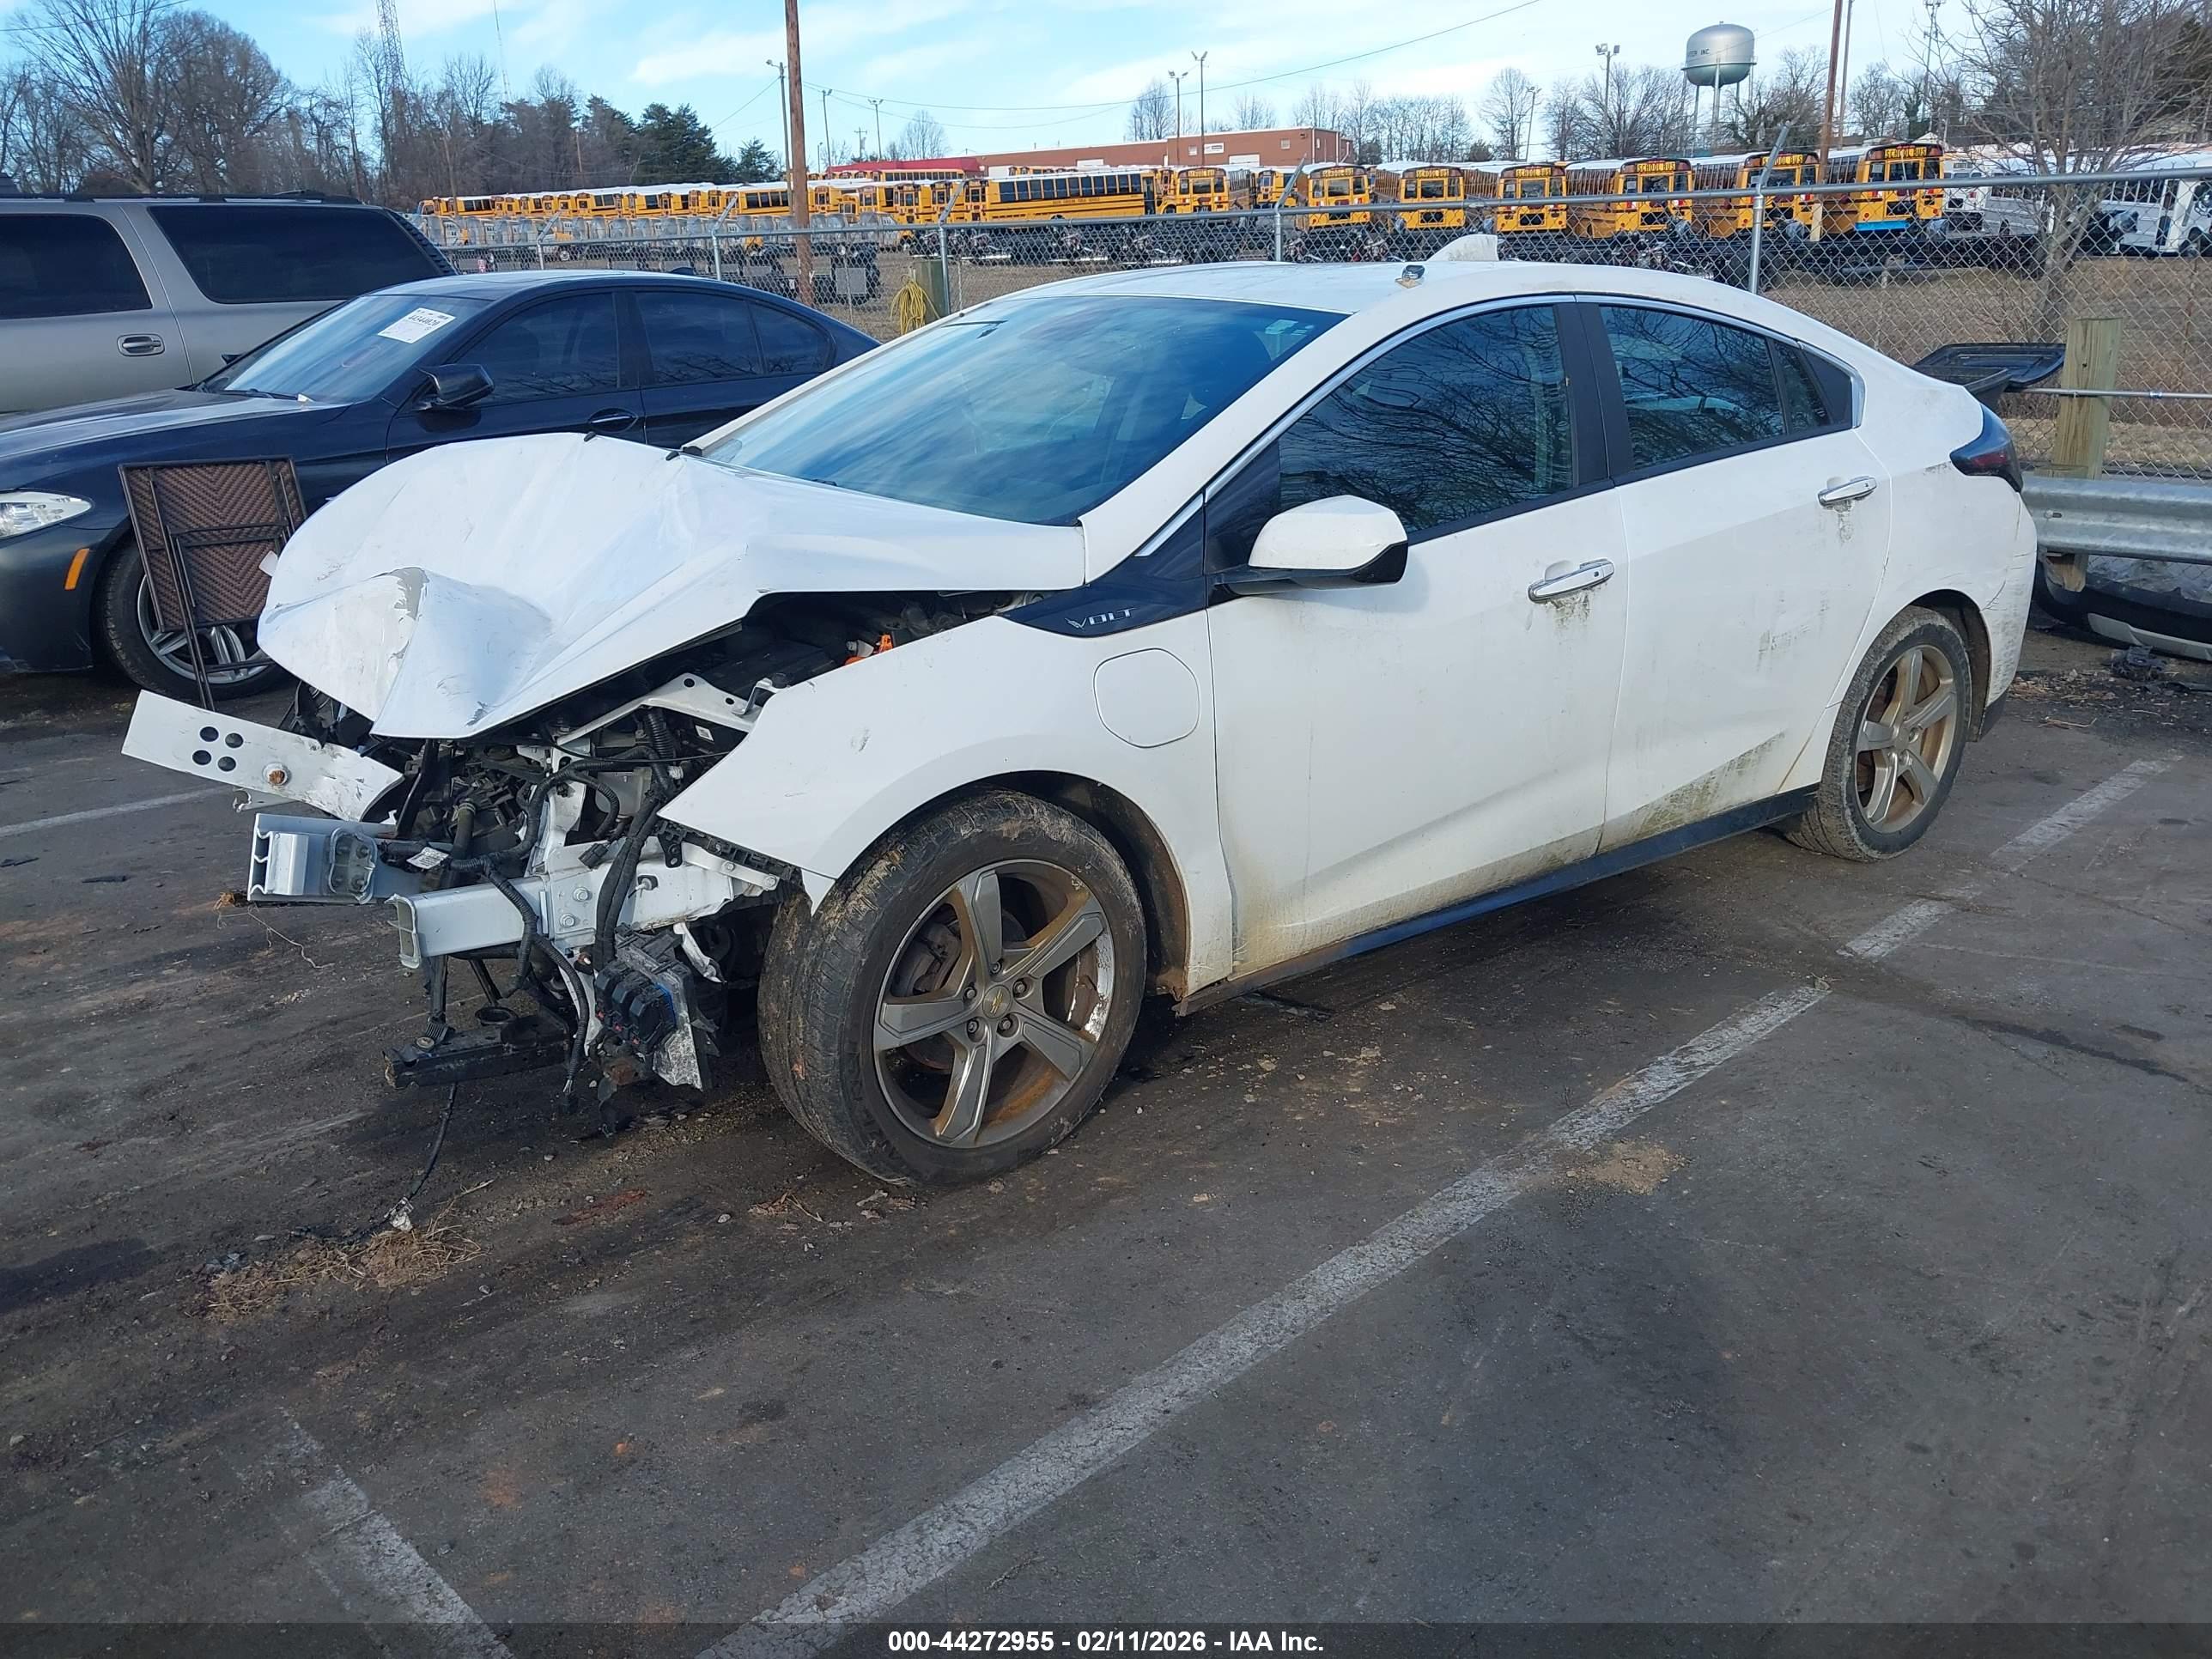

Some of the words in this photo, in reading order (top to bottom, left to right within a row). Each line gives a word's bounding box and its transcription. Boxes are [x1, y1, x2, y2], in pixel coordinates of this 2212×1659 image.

[1914, 147, 1926, 157] BUS
[1763, 156, 1786, 166] SOOL
[1790, 154, 1802, 164] BUS
[1638, 163, 1661, 173] SCHOOL
[1663, 161, 1674, 172] BUS
[1064, 608, 1140, 630] VOLT
